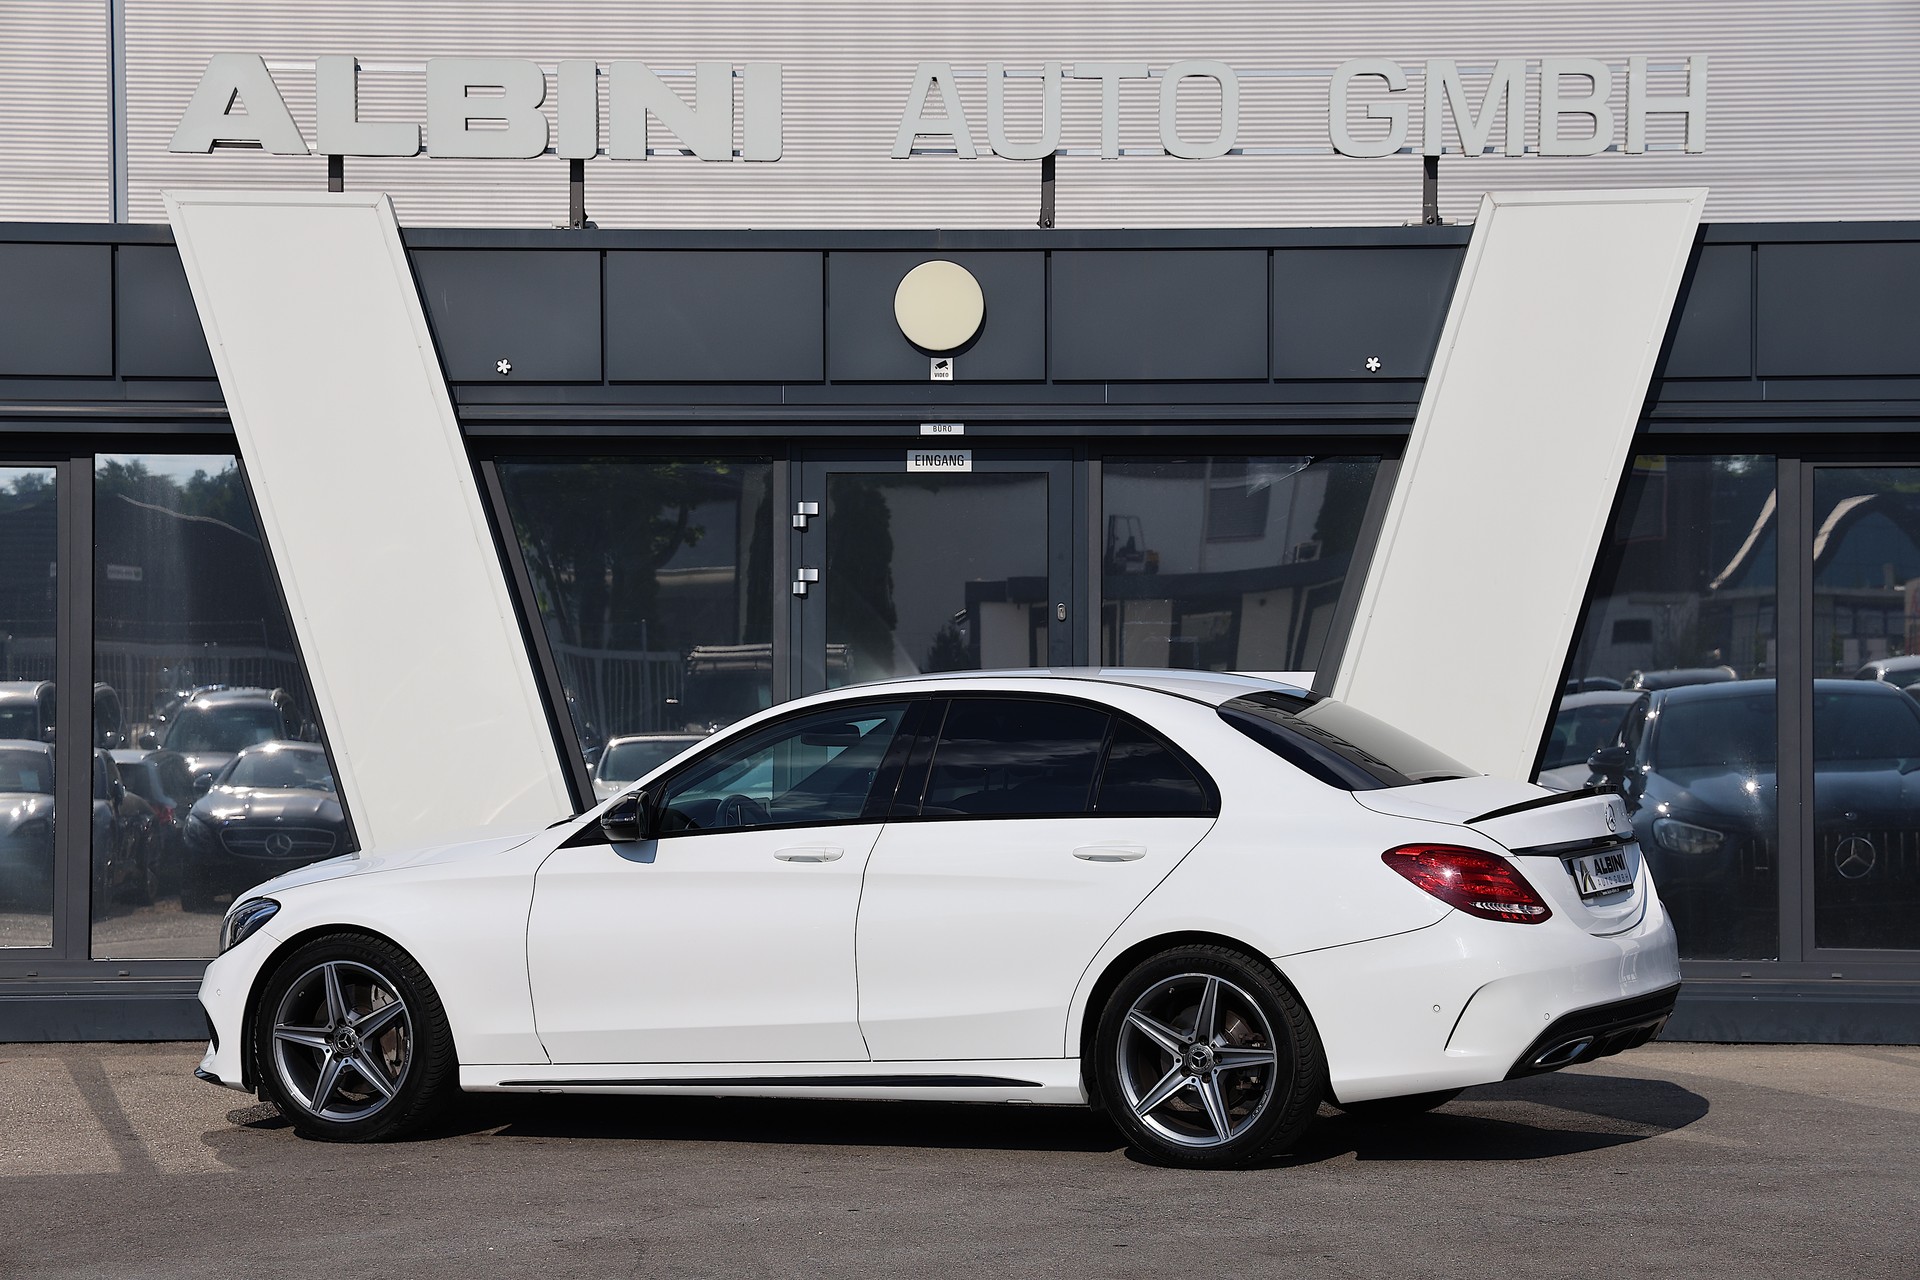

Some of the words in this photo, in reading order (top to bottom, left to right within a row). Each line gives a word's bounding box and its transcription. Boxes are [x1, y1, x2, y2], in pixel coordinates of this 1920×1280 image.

[168, 53, 782, 162] ALBINI
[891, 59, 1240, 161] AUTO
[1328, 55, 1708, 157] GMBH
[932, 424, 953, 433] BÜRO
[915, 454, 965, 467] EINGANG
[1593, 853, 1626, 876] ALBINI
